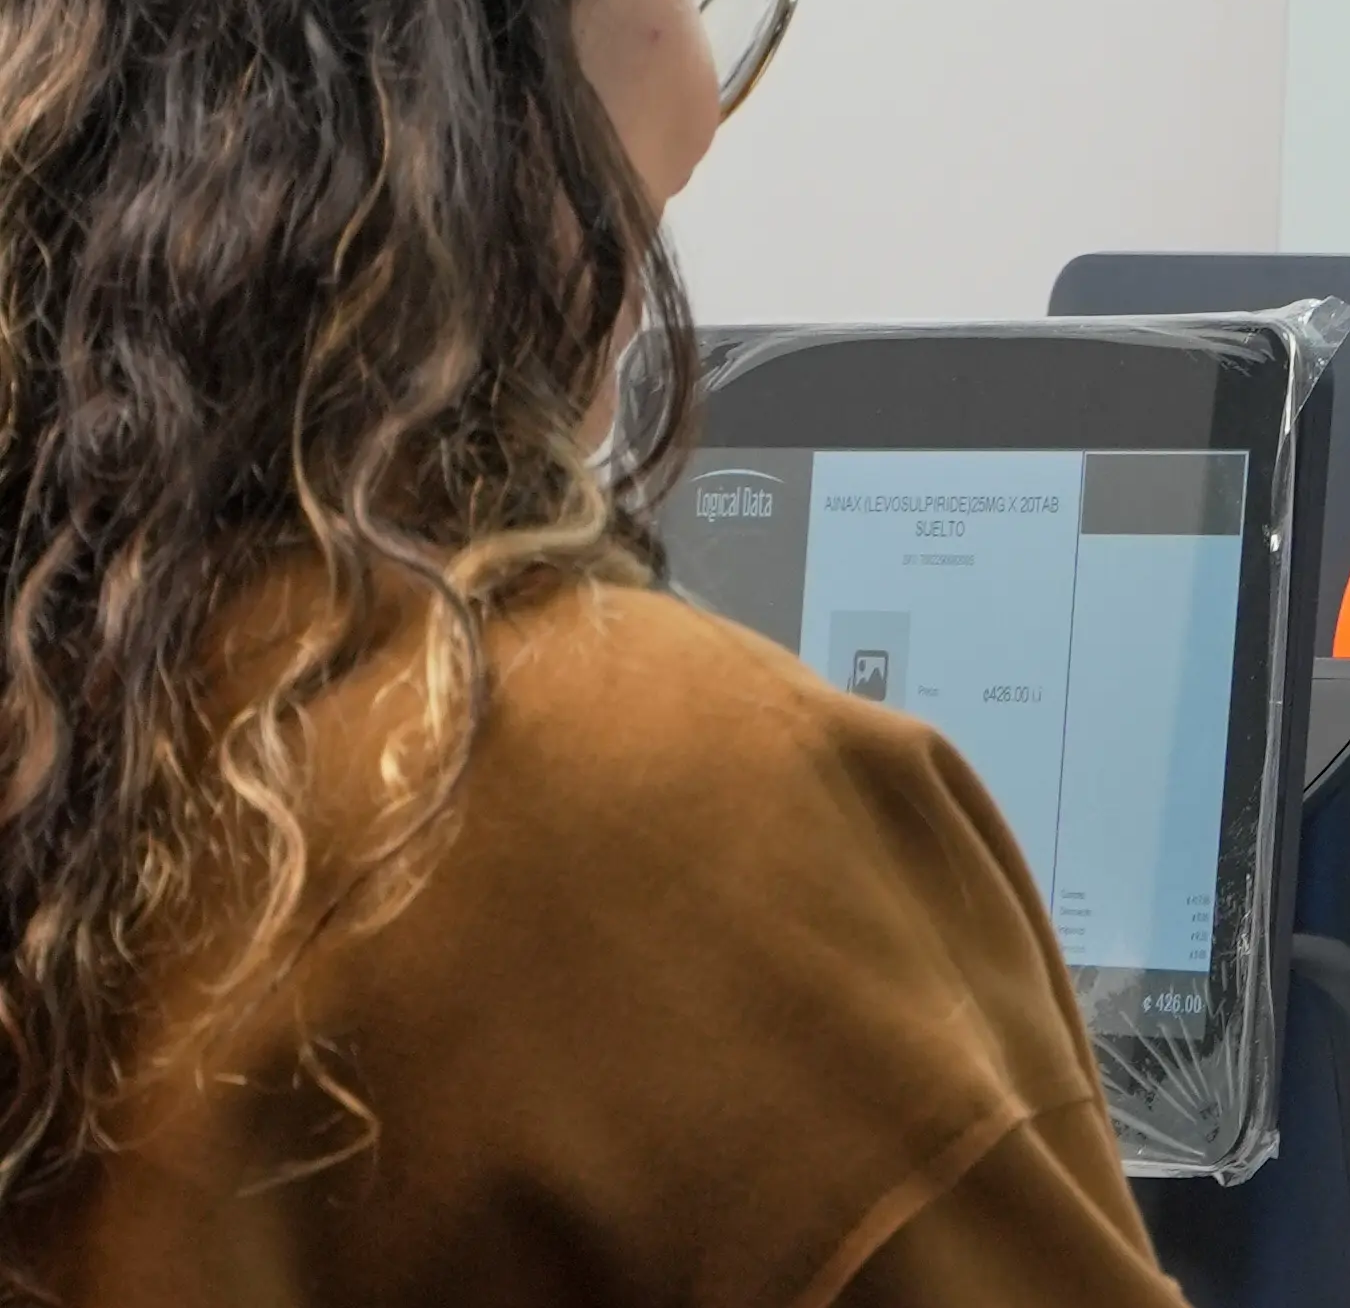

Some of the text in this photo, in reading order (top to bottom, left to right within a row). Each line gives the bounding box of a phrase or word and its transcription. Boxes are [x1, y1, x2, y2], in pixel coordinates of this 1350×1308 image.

[696, 487, 774, 522] Logical Data
[824, 495, 862, 512] AINAX
[1008, 496, 1021, 512] X
[1021, 496, 1060, 512] 20TAB
[915, 520, 966, 537] SUELTO
[1154, 993, 1203, 1013] 426.00
